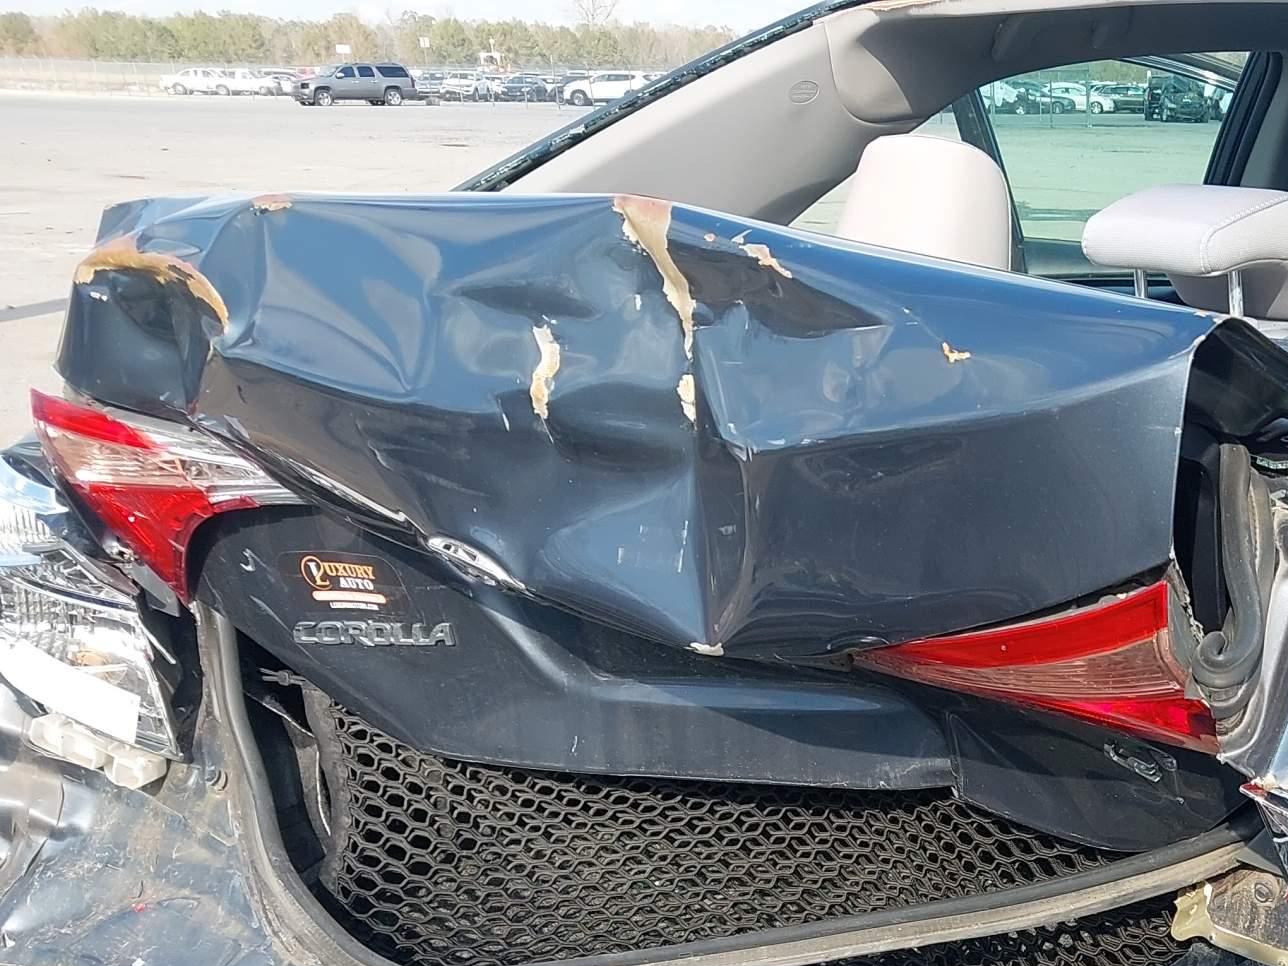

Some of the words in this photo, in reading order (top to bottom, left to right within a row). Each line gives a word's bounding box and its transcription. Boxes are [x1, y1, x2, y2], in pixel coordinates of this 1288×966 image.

[303, 559, 376, 587] LUXURY
[339, 577, 375, 591] AUTO
[293, 620, 457, 647] COROLLA
